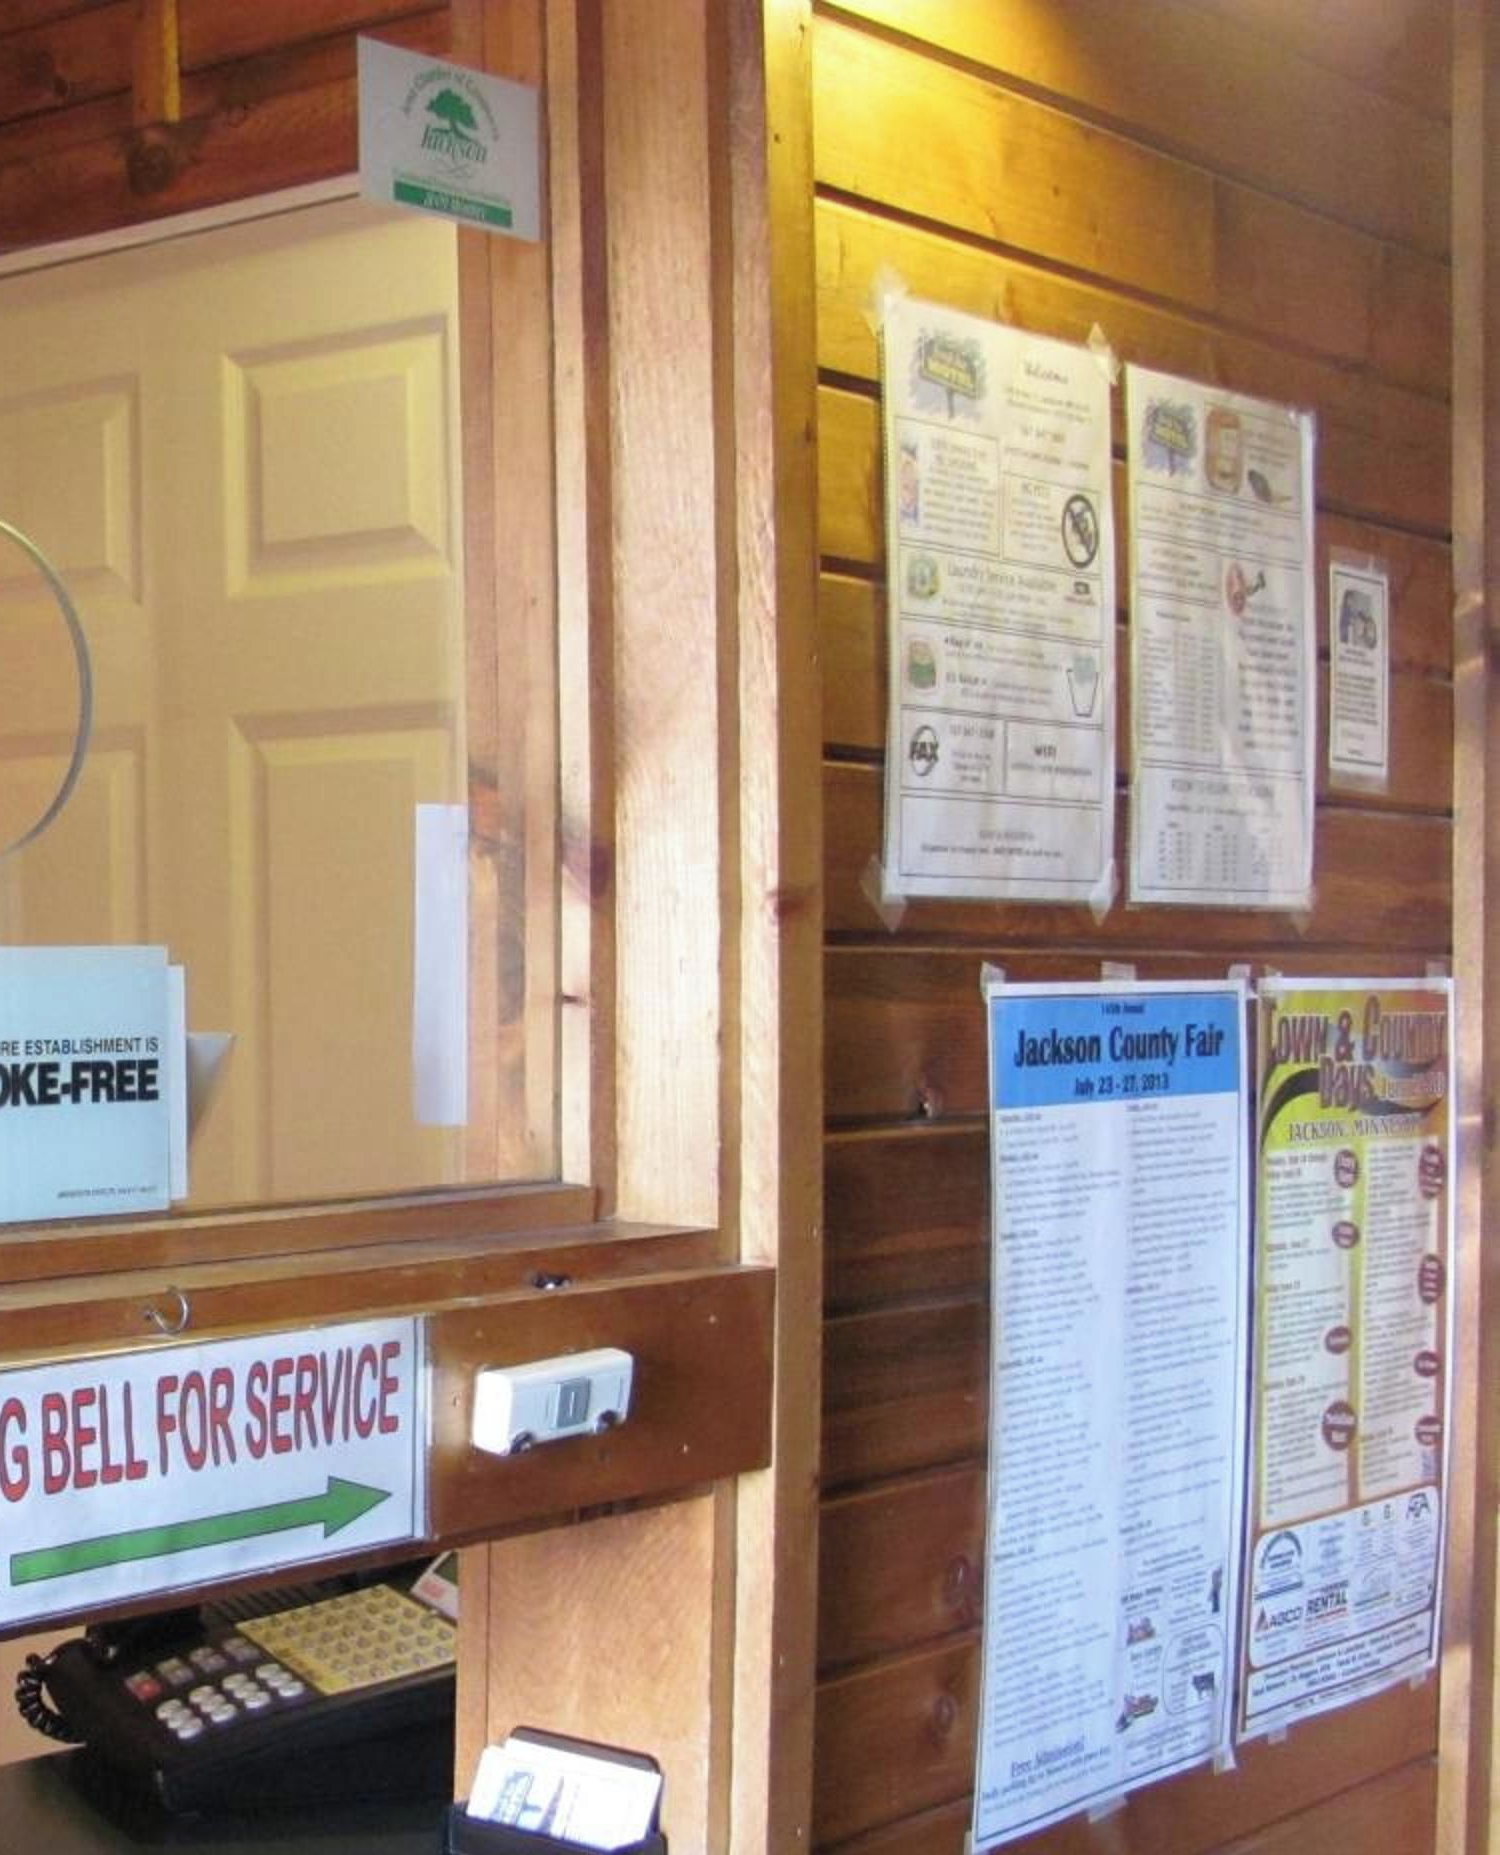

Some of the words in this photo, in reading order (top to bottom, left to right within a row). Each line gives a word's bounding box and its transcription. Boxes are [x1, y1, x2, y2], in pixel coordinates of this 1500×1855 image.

[24, 1036, 142, 1056] ESTABLISHMENT
[145, 1036, 160, 1054] IS
[1014, 1029, 1101, 1067] Jackson
[1108, 1025, 1178, 1066] County
[1184, 1022, 1224, 1057] Fair
[1335, 1010, 1355, 1061] &
[1075, 1078, 1095, 1098] July
[1098, 1077, 1113, 1094] 23
[1141, 1073, 1169, 1092] 2013
[42, 1380, 148, 1496] BELL
[157, 1366, 237, 1476] FOR
[244, 1340, 402, 1460] SERVICE
